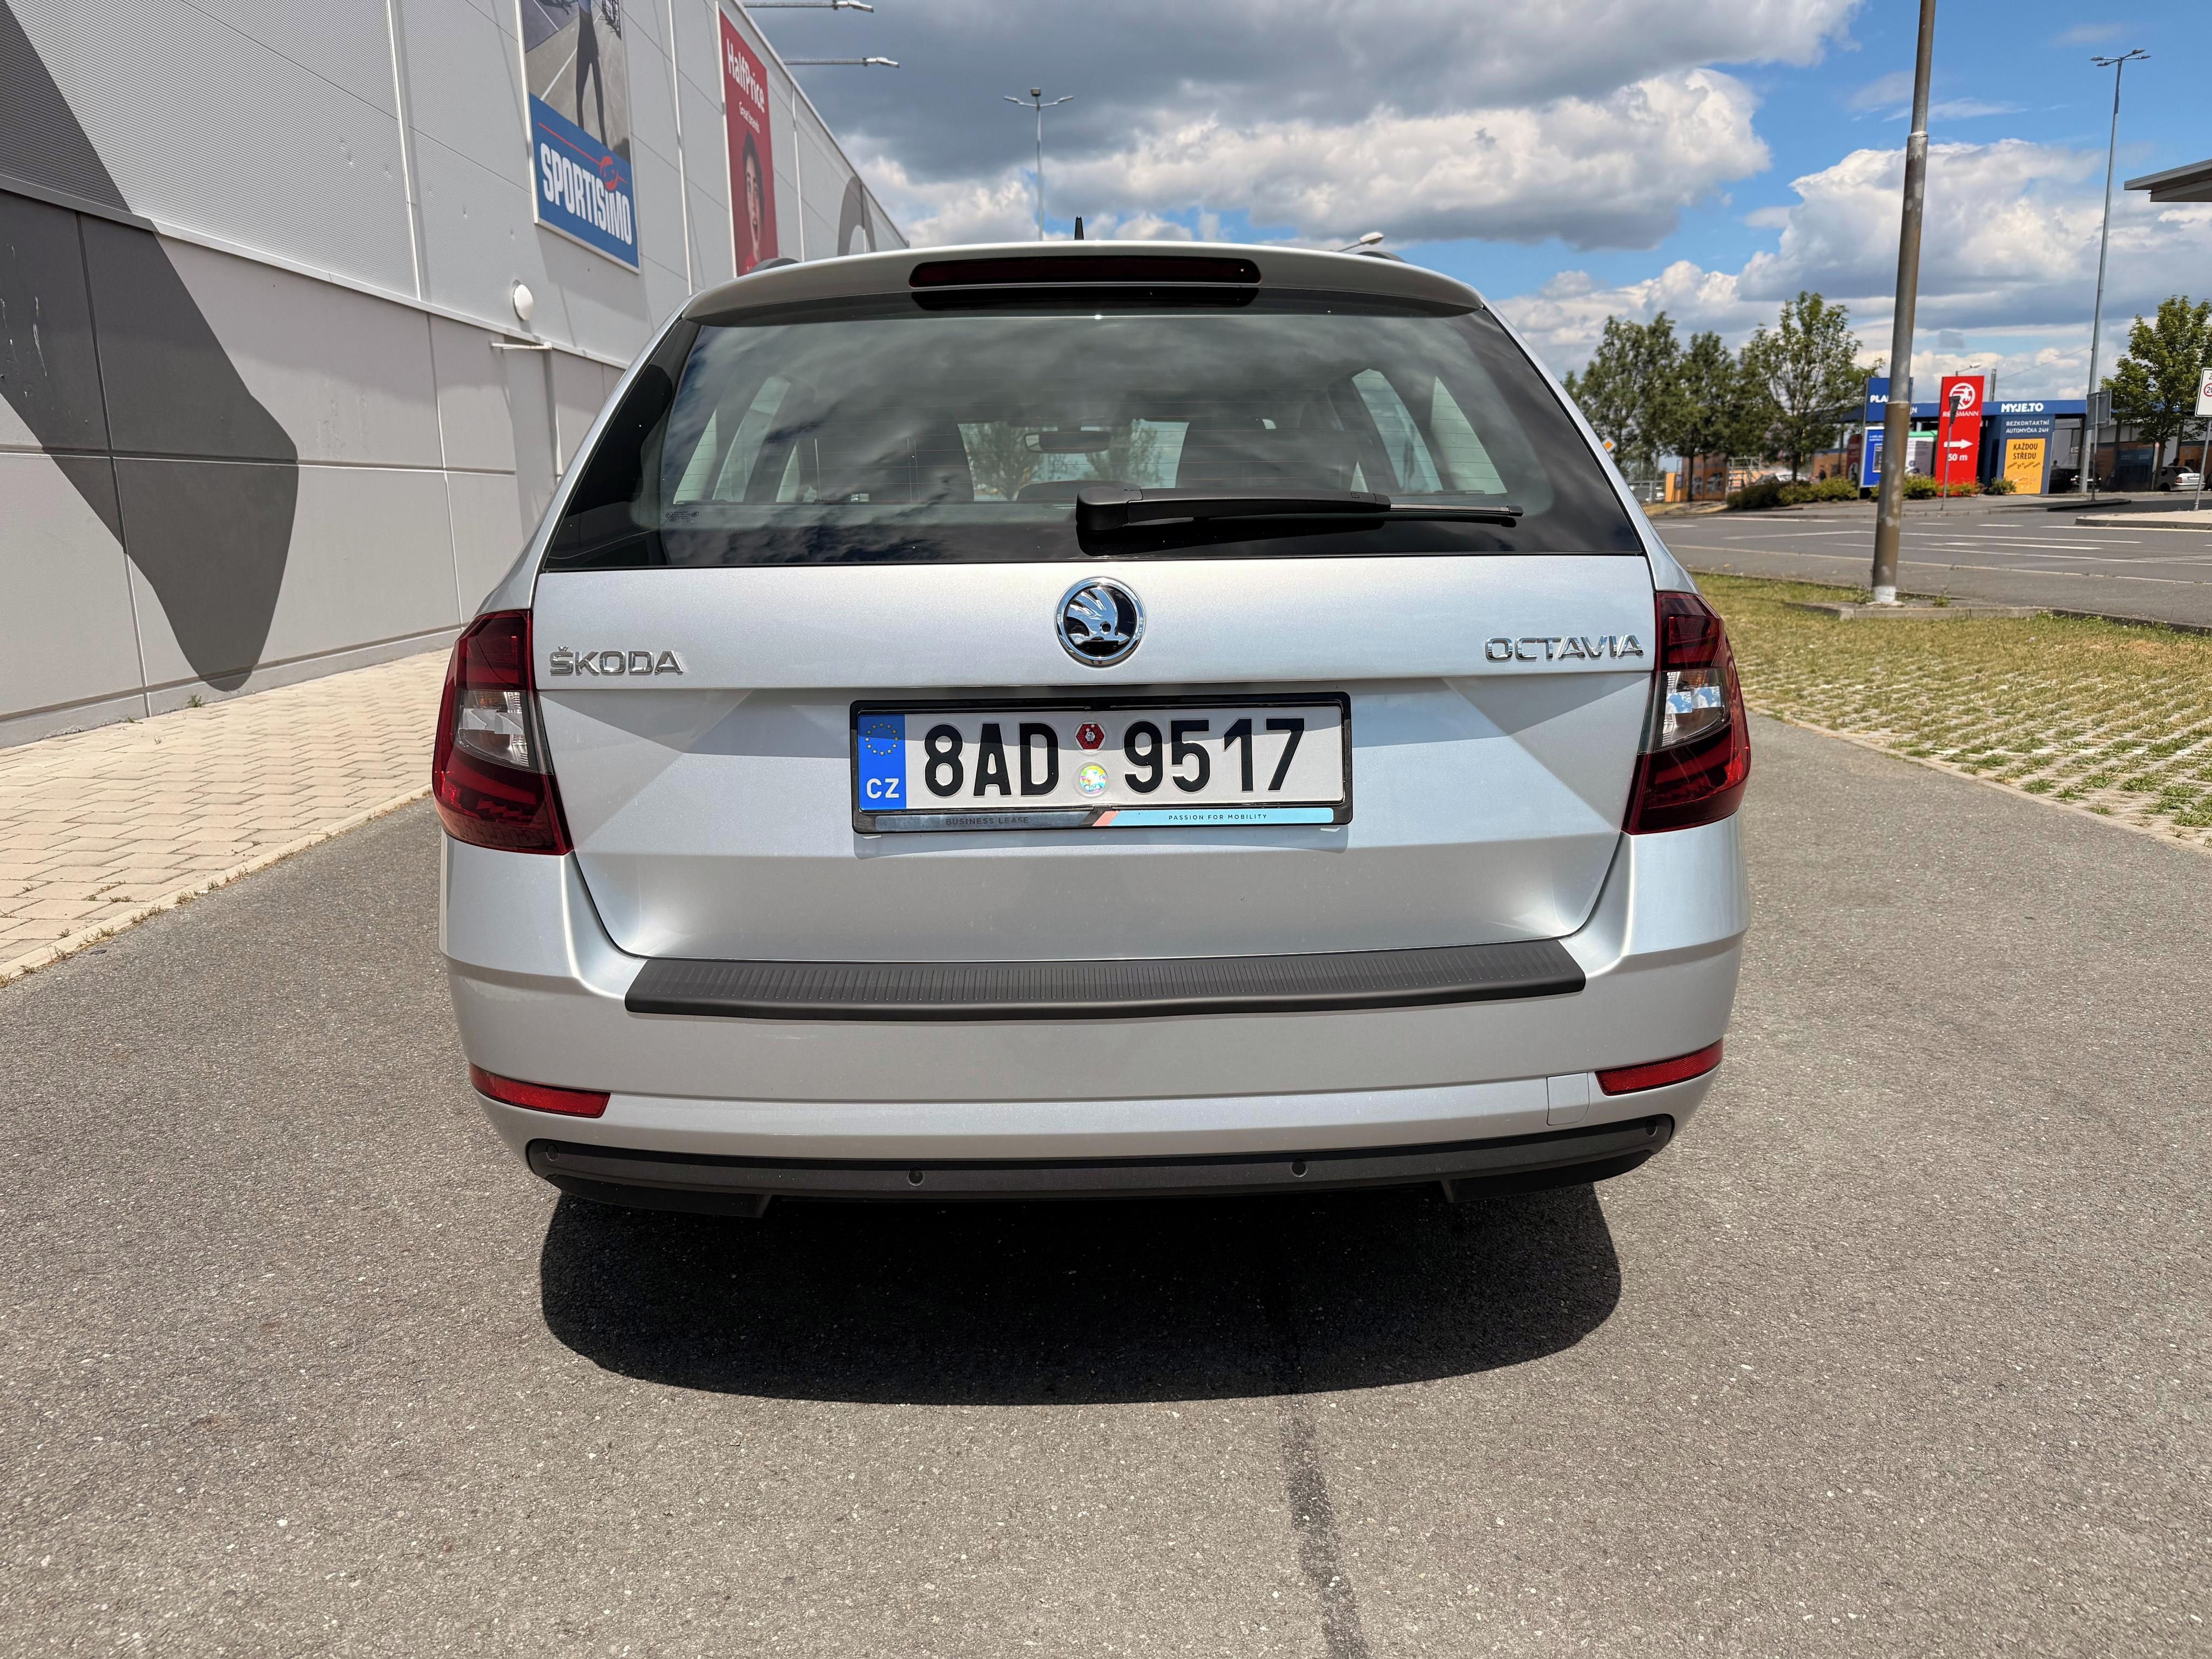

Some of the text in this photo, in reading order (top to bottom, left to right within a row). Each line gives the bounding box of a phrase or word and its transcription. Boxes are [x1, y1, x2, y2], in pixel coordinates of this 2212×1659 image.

[727, 38, 765, 113] HalfPrice
[541, 143, 632, 245] SPORTISIMO
[1870, 395, 1889, 403] PLA
[2001, 402, 2044, 413] MYJE.TO
[1947, 453, 1958, 461] 50
[2013, 451, 2036, 460] STŘEDU
[1485, 634, 1644, 661] OCTAVIA
[550, 645, 684, 675] ŠKODA
[924, 718, 1305, 797] 8AD 9517
[866, 778, 899, 798] CZ
